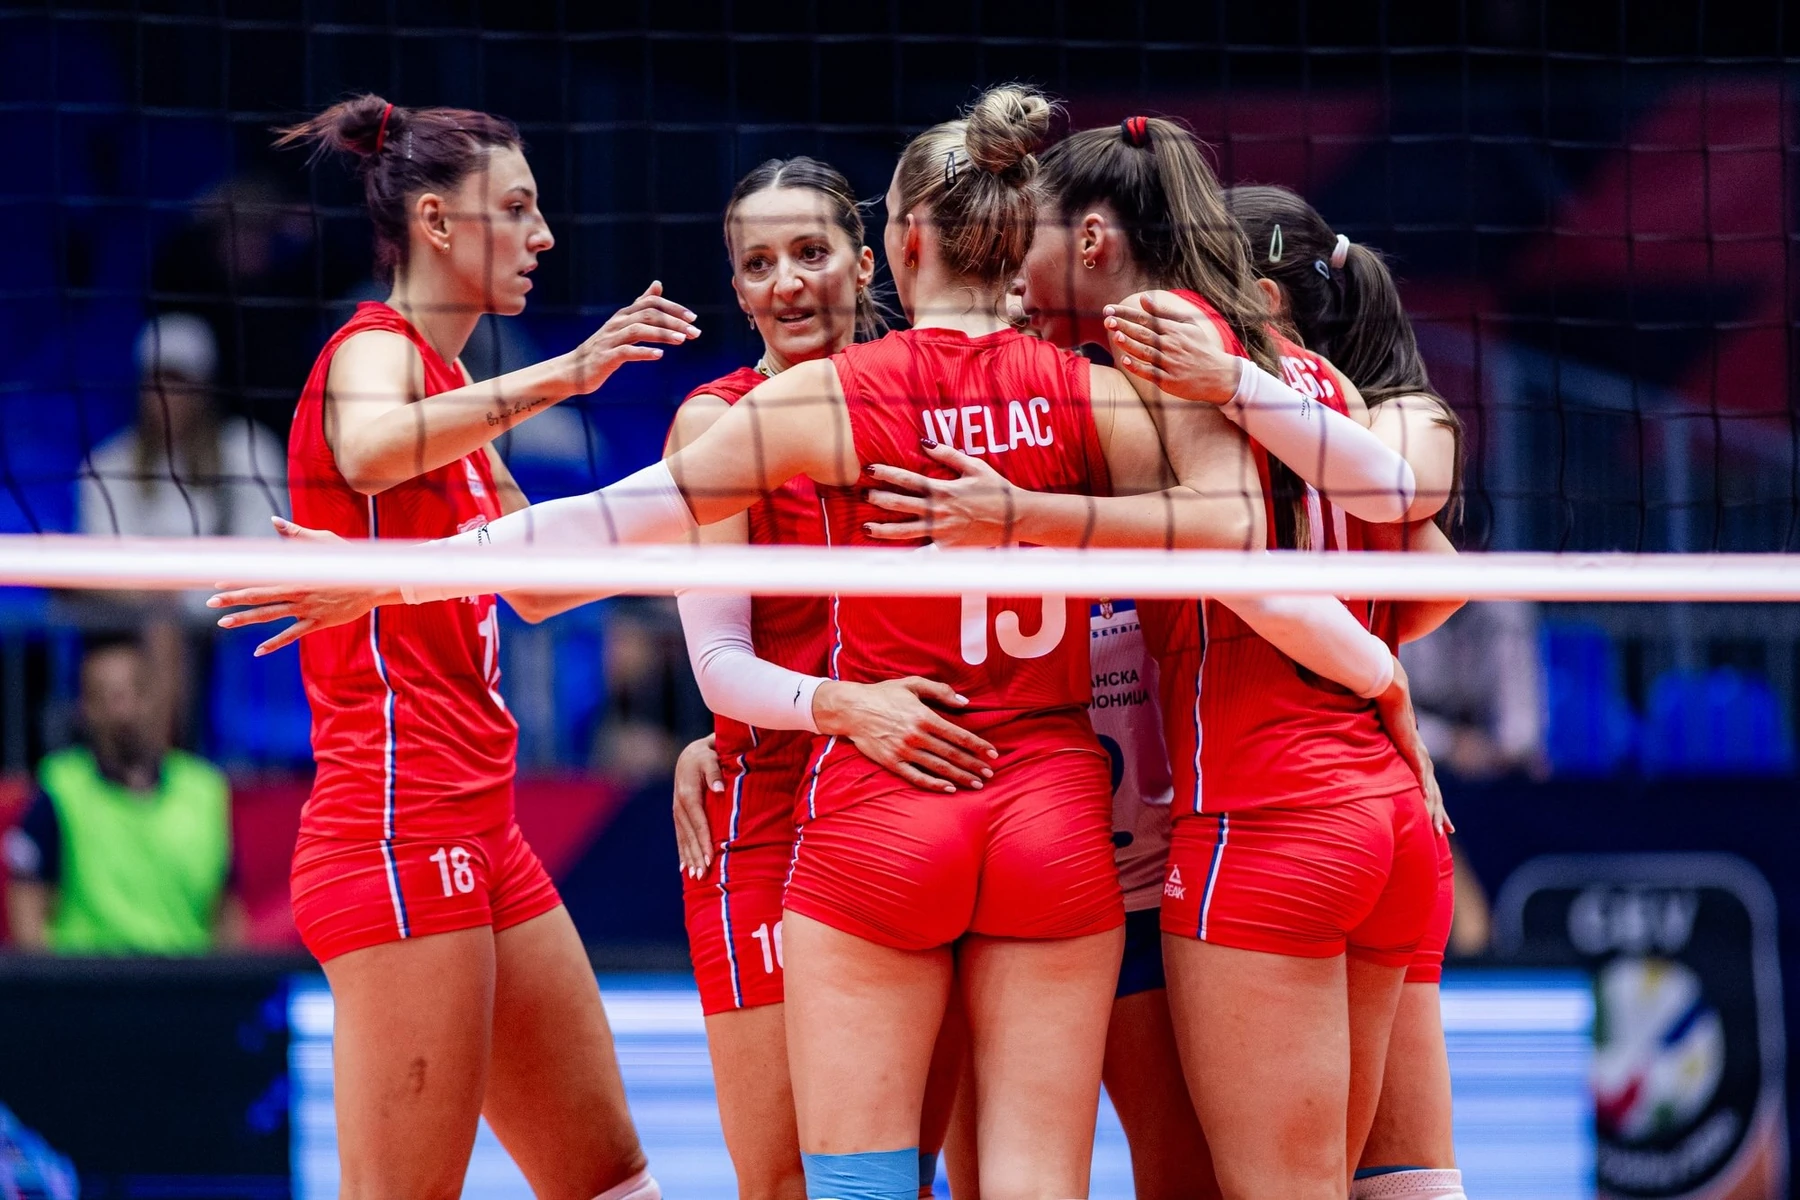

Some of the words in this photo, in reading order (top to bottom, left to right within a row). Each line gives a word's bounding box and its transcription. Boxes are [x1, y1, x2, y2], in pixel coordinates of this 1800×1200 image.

[922, 397, 1054, 456] UZELAC
[1091, 623, 1141, 639] SERBIA
[1091, 669, 1140, 689] НСКА
[429, 846, 475, 898] 18
[1163, 882, 1187, 901] PEAK
